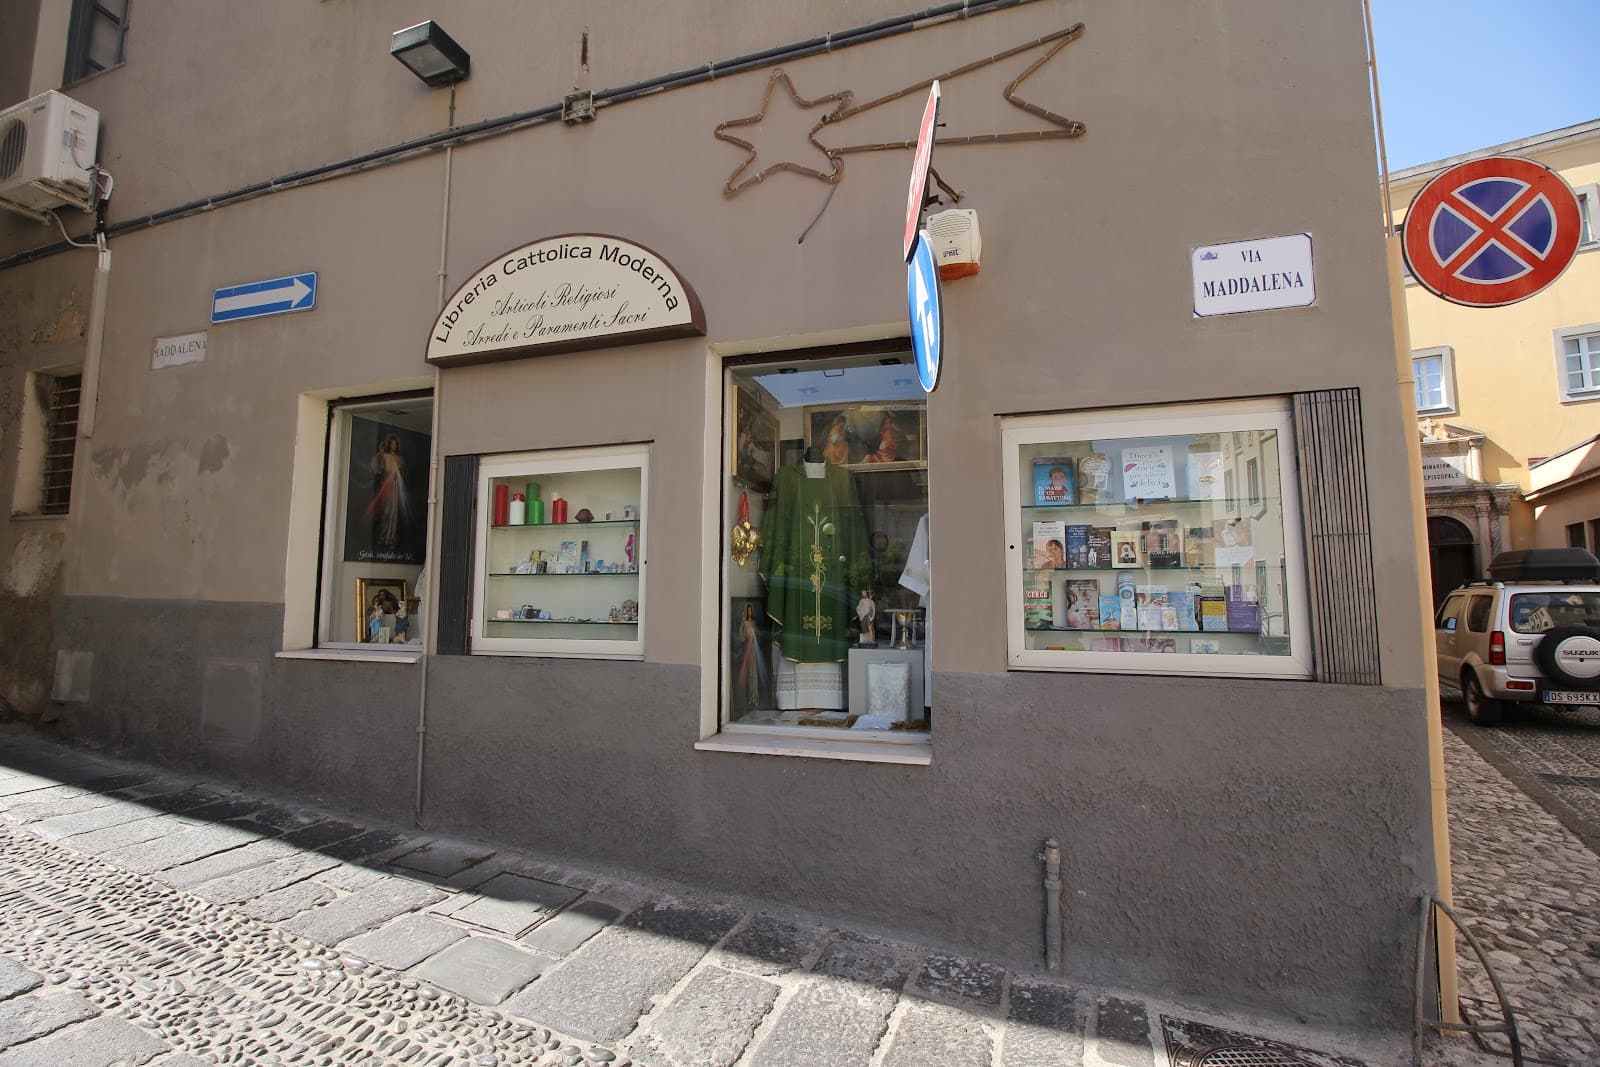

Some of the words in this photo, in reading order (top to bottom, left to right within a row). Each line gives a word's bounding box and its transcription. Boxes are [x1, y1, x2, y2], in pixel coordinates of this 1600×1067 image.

[1241, 249, 1262, 263] VIA
[436, 272, 498, 344] Libreria
[503, 243, 592, 276] Cattolica
[599, 243, 679, 312] Moderna
[490, 291, 551, 317] Articoli
[550, 282, 620, 312] Religiosi
[1203, 271, 1304, 298] MADDALENA
[463, 322, 511, 347] Arredi
[512, 330, 519, 342] e
[523, 314, 602, 339] Paramenti
[602, 301, 651, 328] Sacri
